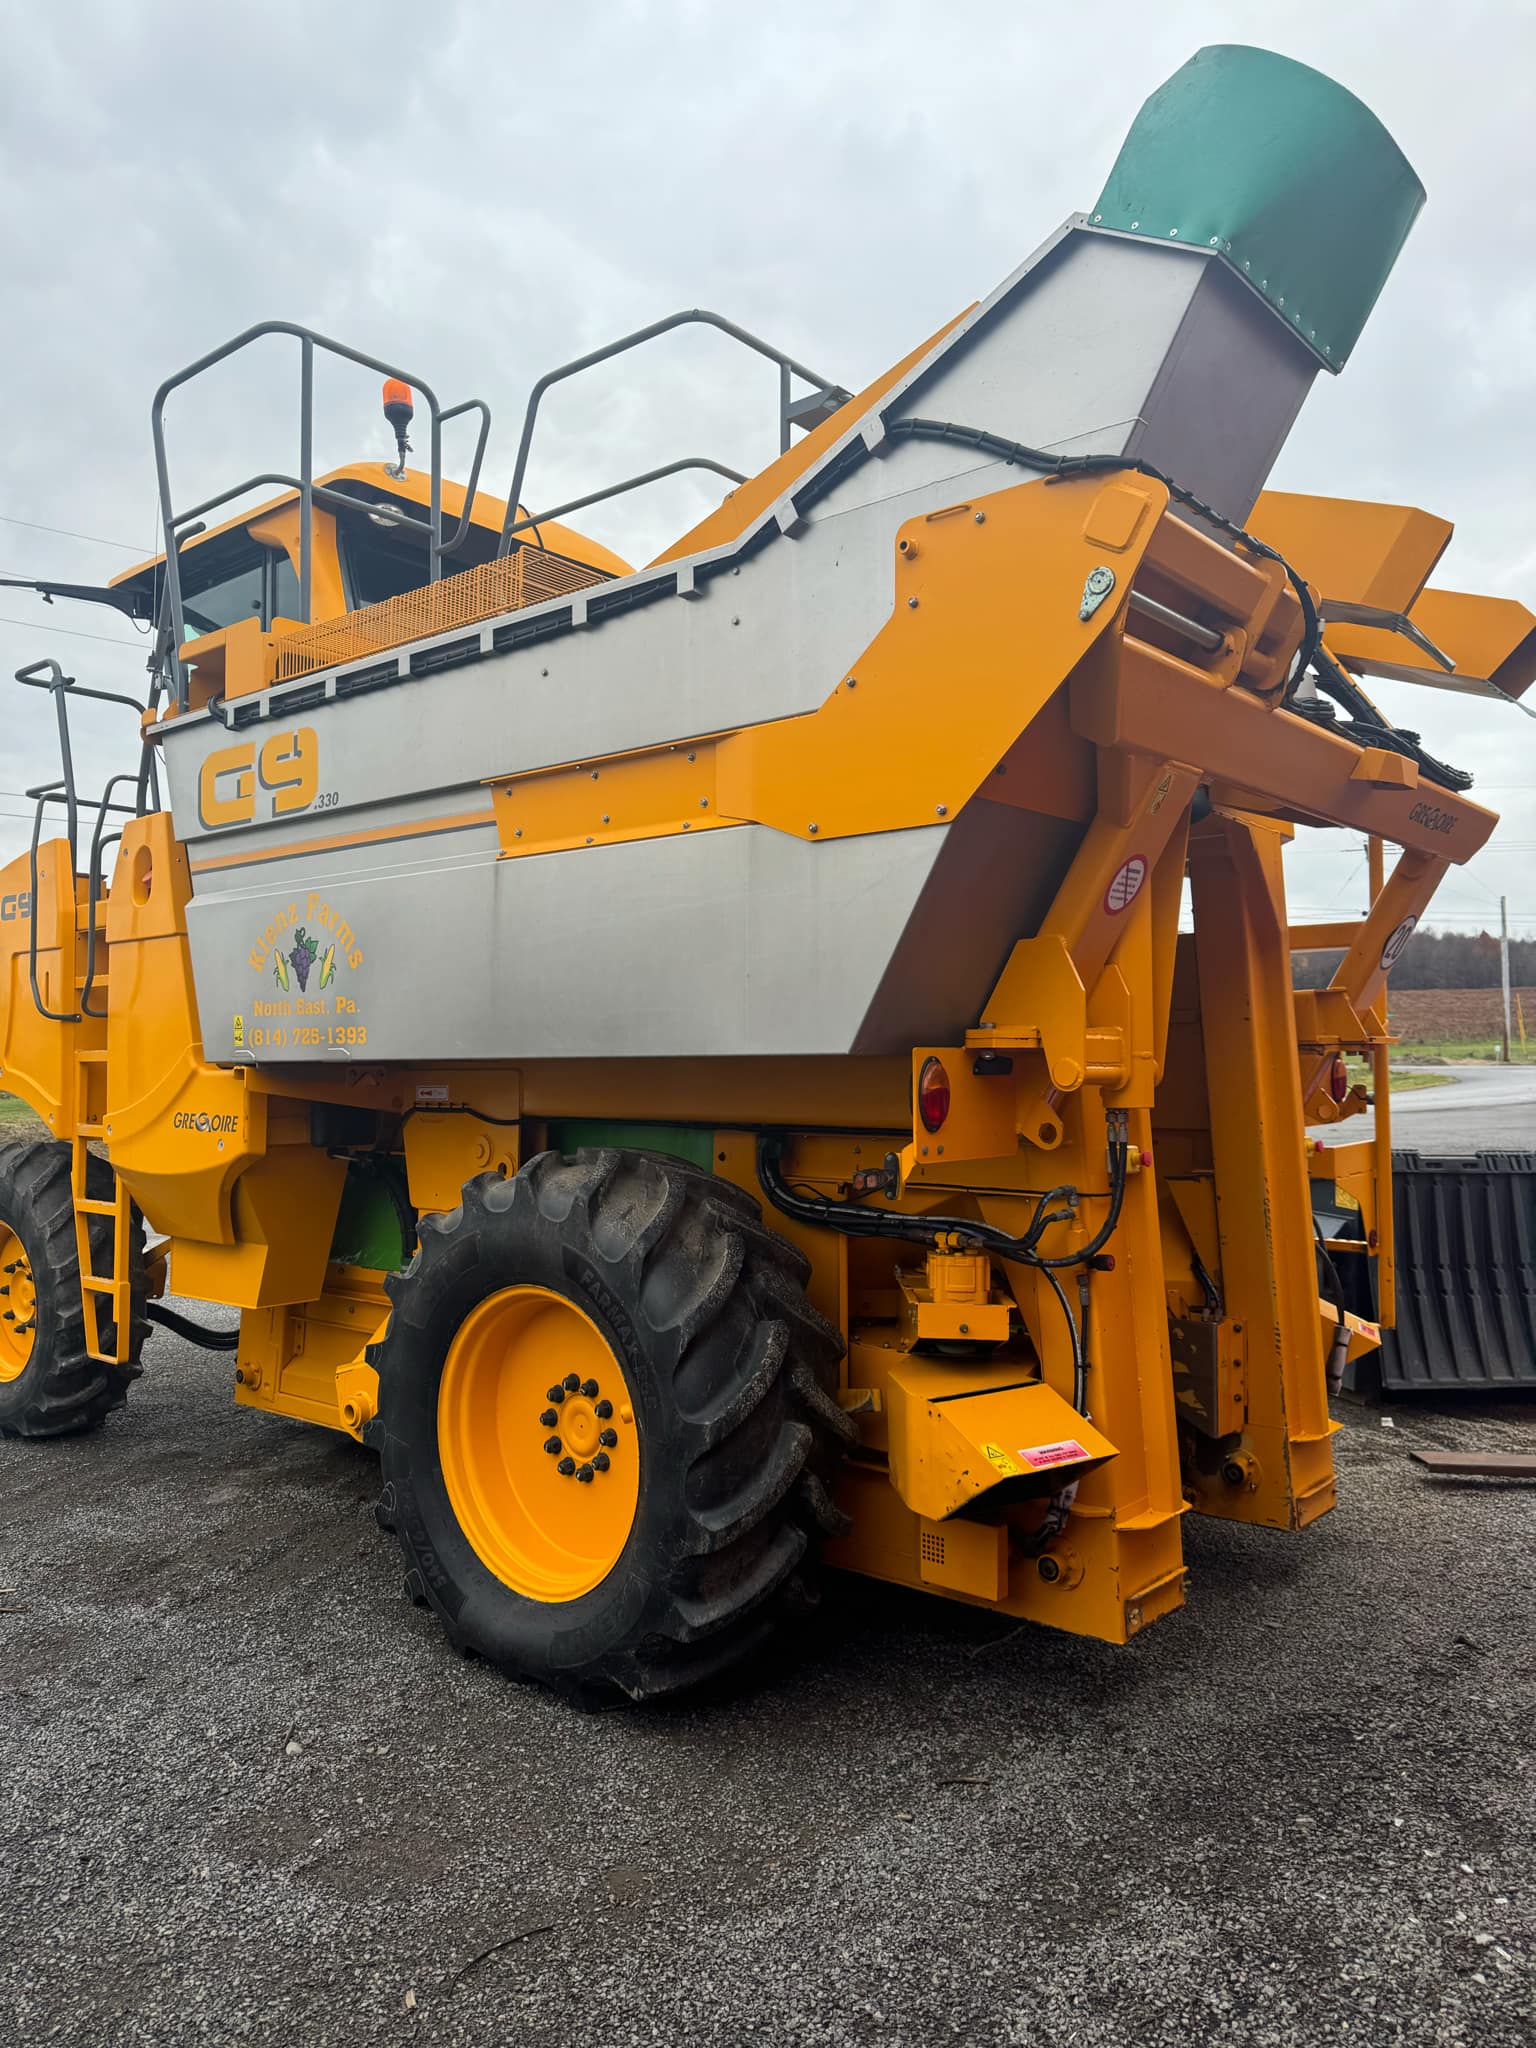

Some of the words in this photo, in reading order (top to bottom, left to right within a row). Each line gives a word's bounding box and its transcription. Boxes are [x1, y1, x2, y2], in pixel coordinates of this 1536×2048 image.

[247, 901, 299, 974] Klenz
[306, 892, 364, 969] Farms
[1384, 924, 1411, 960] 20
[253, 999, 291, 1016] North
[335, 996, 361, 1014] Pa.
[247, 1026, 287, 1048] (814)
[292, 1026, 367, 1045] 725-1393
[173, 1111, 239, 1132] GREGOIRE
[580, 1269, 641, 1359] FARMAX
